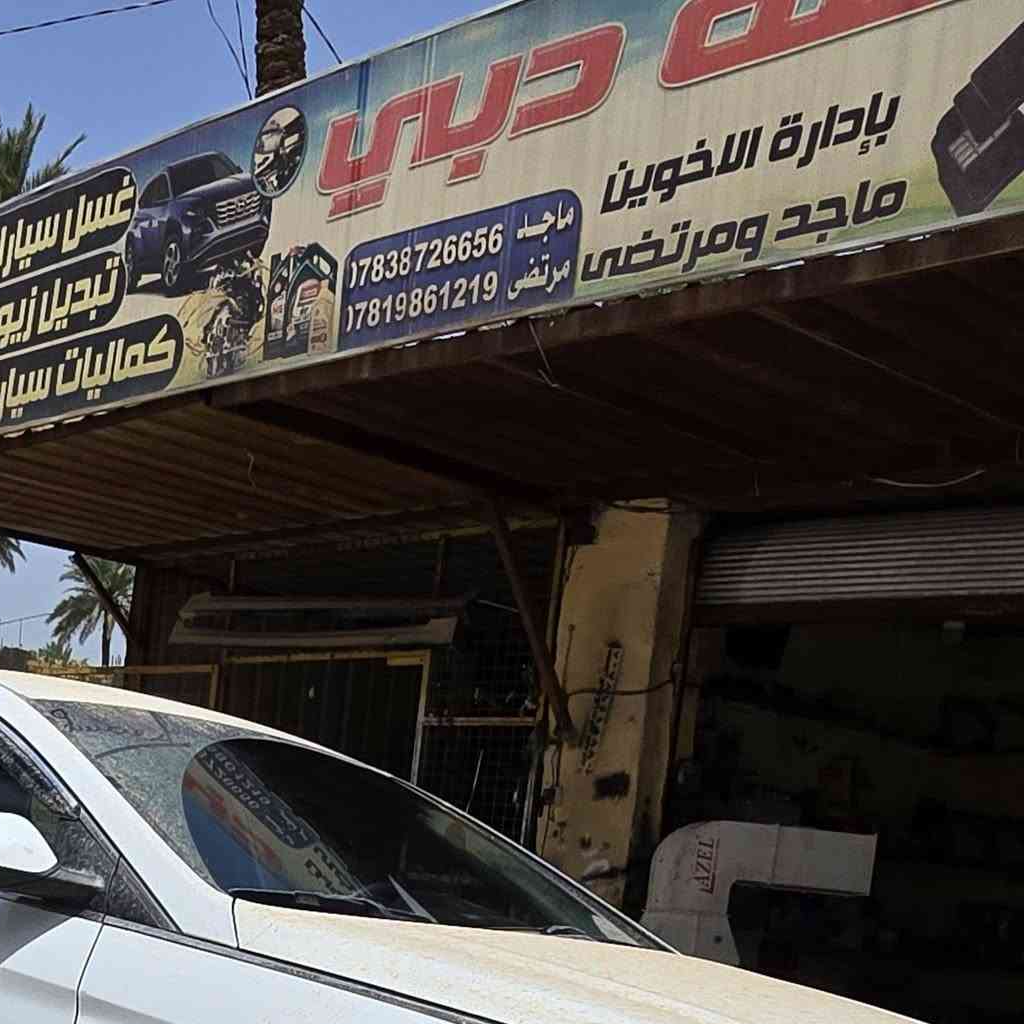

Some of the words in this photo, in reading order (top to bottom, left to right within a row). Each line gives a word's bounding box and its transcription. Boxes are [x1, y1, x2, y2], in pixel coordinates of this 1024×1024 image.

[317, 22, 627, 222] دبي
[768, 92, 901, 169] بإدارة
[600, 126, 763, 214] الاخوين
[61, 175, 135, 253] غسل
[517, 201, 575, 243] ماجد
[580, 214, 769, 282] ومرتضى
[774, 180, 908, 243] ماجد
[37, 256, 121, 335] تبديل
[507, 253, 571, 299] مرتضى
[55, 324, 177, 400] كماليات
